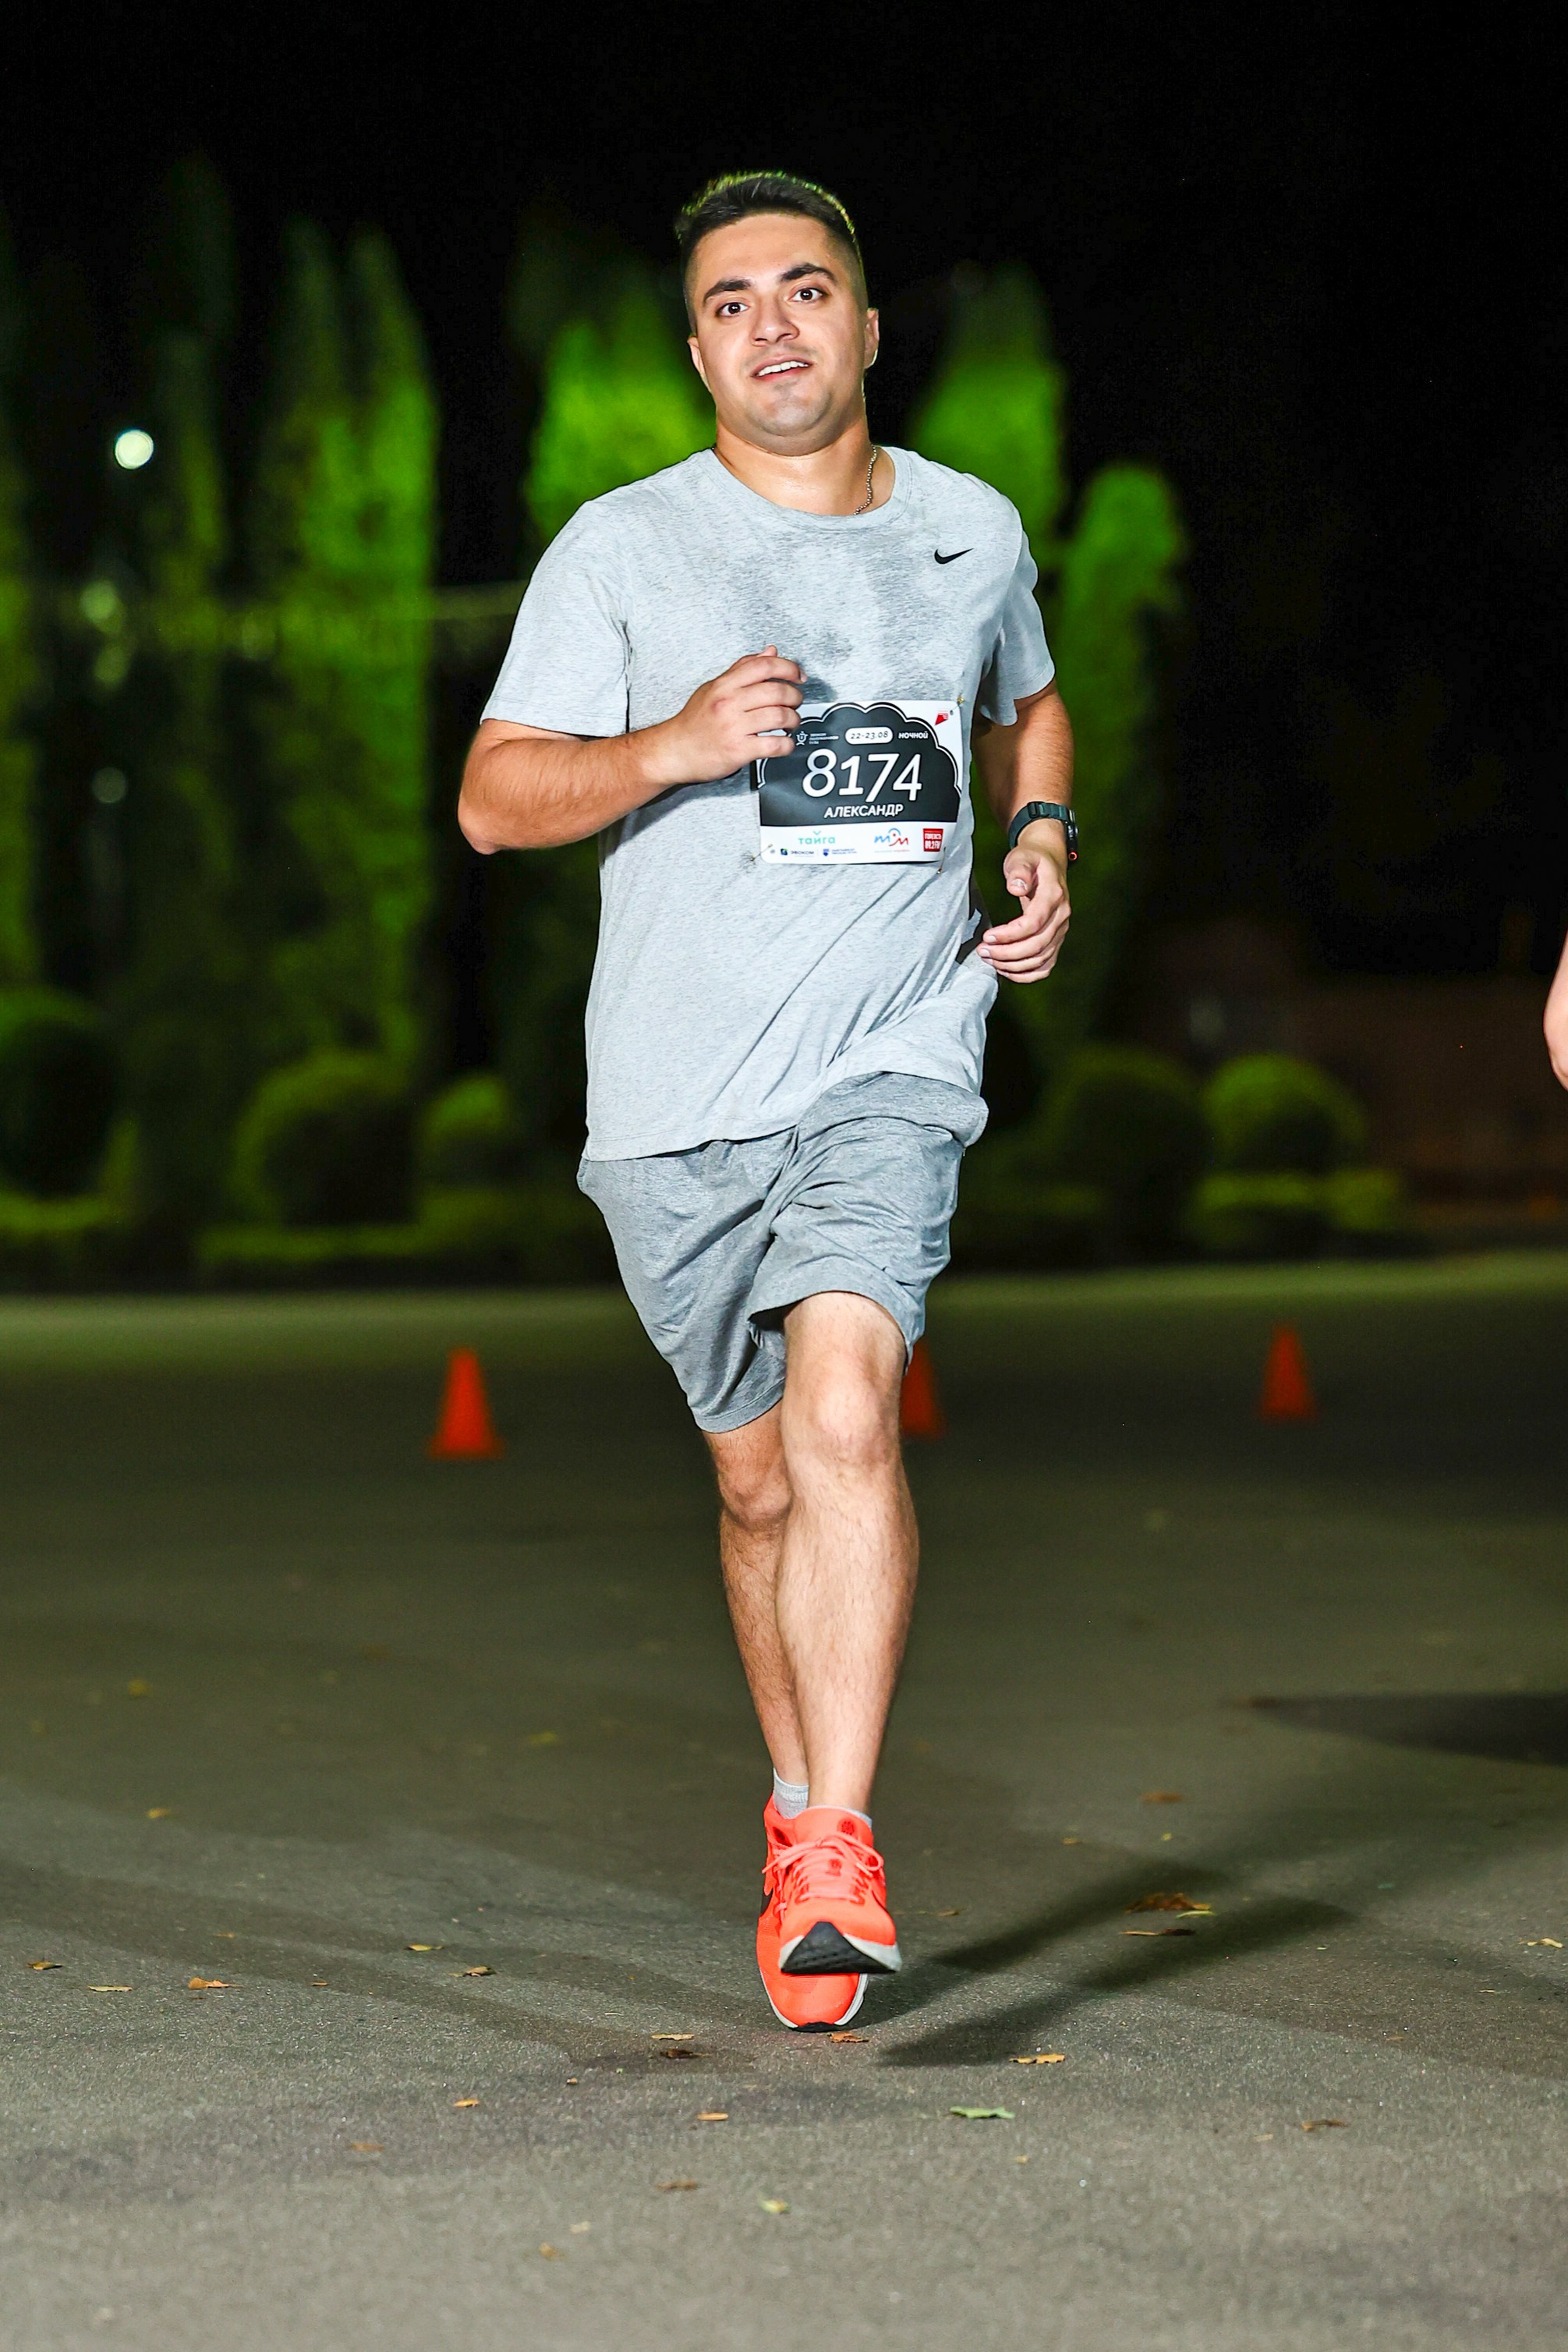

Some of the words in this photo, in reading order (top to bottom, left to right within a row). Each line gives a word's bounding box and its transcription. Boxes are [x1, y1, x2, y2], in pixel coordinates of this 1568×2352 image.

[850, 731, 889, 740] 22-23.08
[897, 731, 929, 739] НОЧНОЙ
[802, 749, 922, 802] 8174
[823, 803, 904, 818] АЛЕКСАНДР
